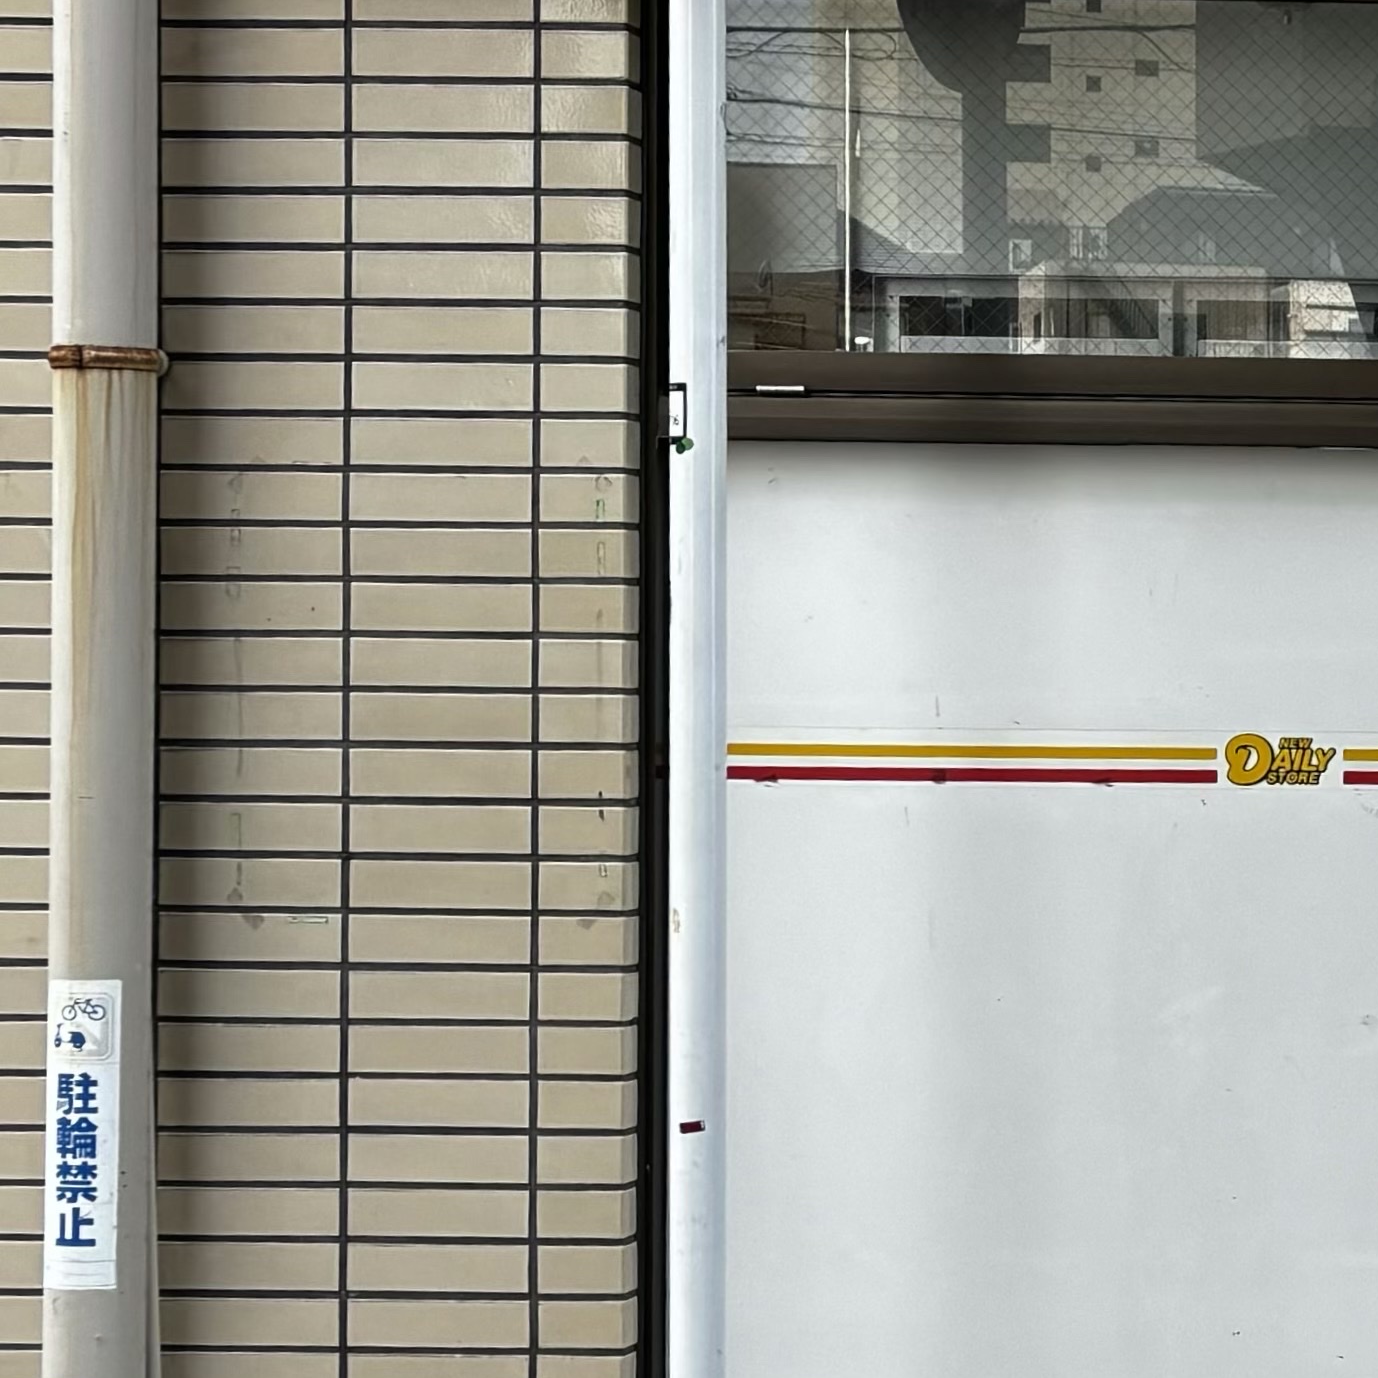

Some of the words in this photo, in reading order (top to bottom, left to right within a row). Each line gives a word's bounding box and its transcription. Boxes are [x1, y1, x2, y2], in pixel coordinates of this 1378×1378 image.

[1225, 733, 1336, 786] DAILY
[1279, 737, 1313, 749] NEW
[1266, 771, 1320, 785] STORE
[55, 1072, 99, 1247] 駐輪禁止
